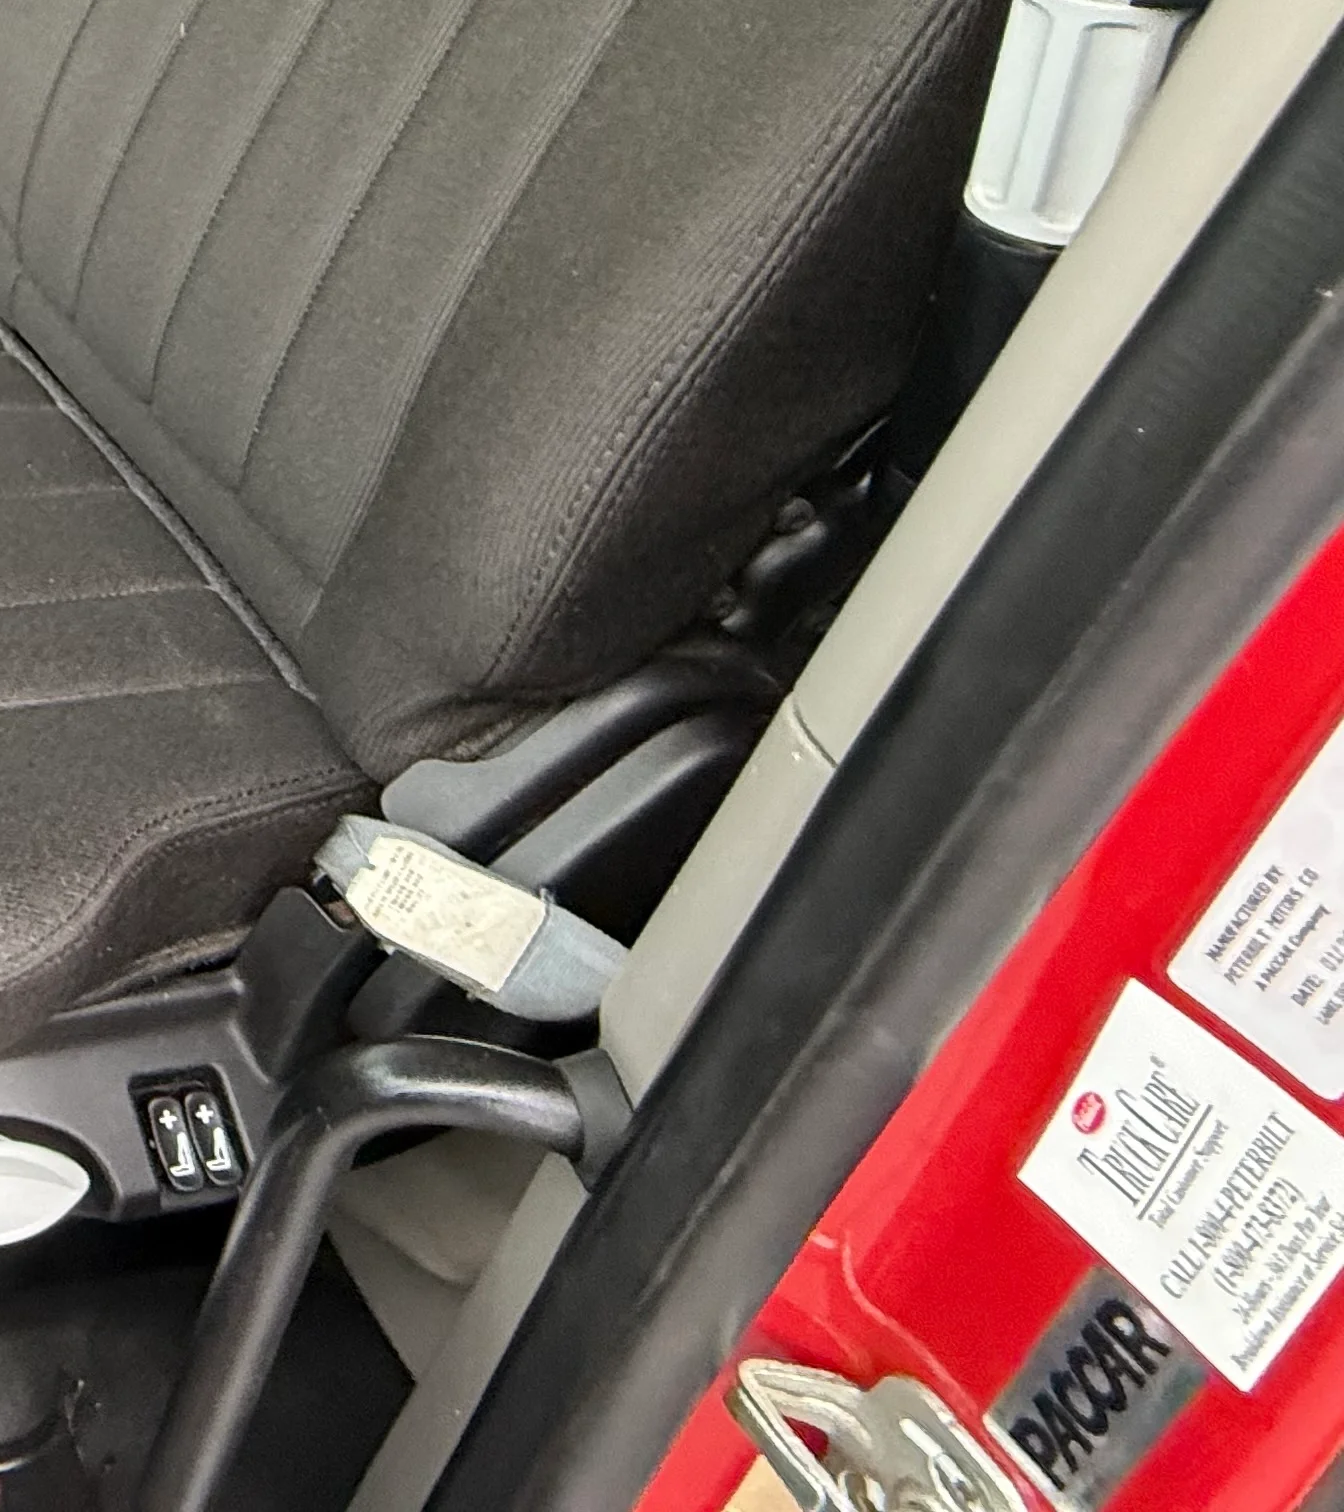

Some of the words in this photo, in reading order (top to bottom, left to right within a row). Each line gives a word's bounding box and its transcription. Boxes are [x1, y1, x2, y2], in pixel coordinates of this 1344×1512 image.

[1205, 882, 1272, 962] MANUFACTURED
[1264, 865, 1284, 884] BY
[1255, 978, 1266, 991] A
[1265, 945, 1294, 982] PACCAR
[1288, 904, 1331, 947] Company
[1266, 888, 1304, 928] MOTORS
[1077, 1120, 1171, 1207] TRUCK
[1148, 1198, 1176, 1229] Total
[1167, 1159, 1204, 1205] Customer
[1194, 1119, 1229, 1161] Support
[1160, 1250, 1204, 1299] CALL
[1009, 1296, 1170, 1492] PACCAR
